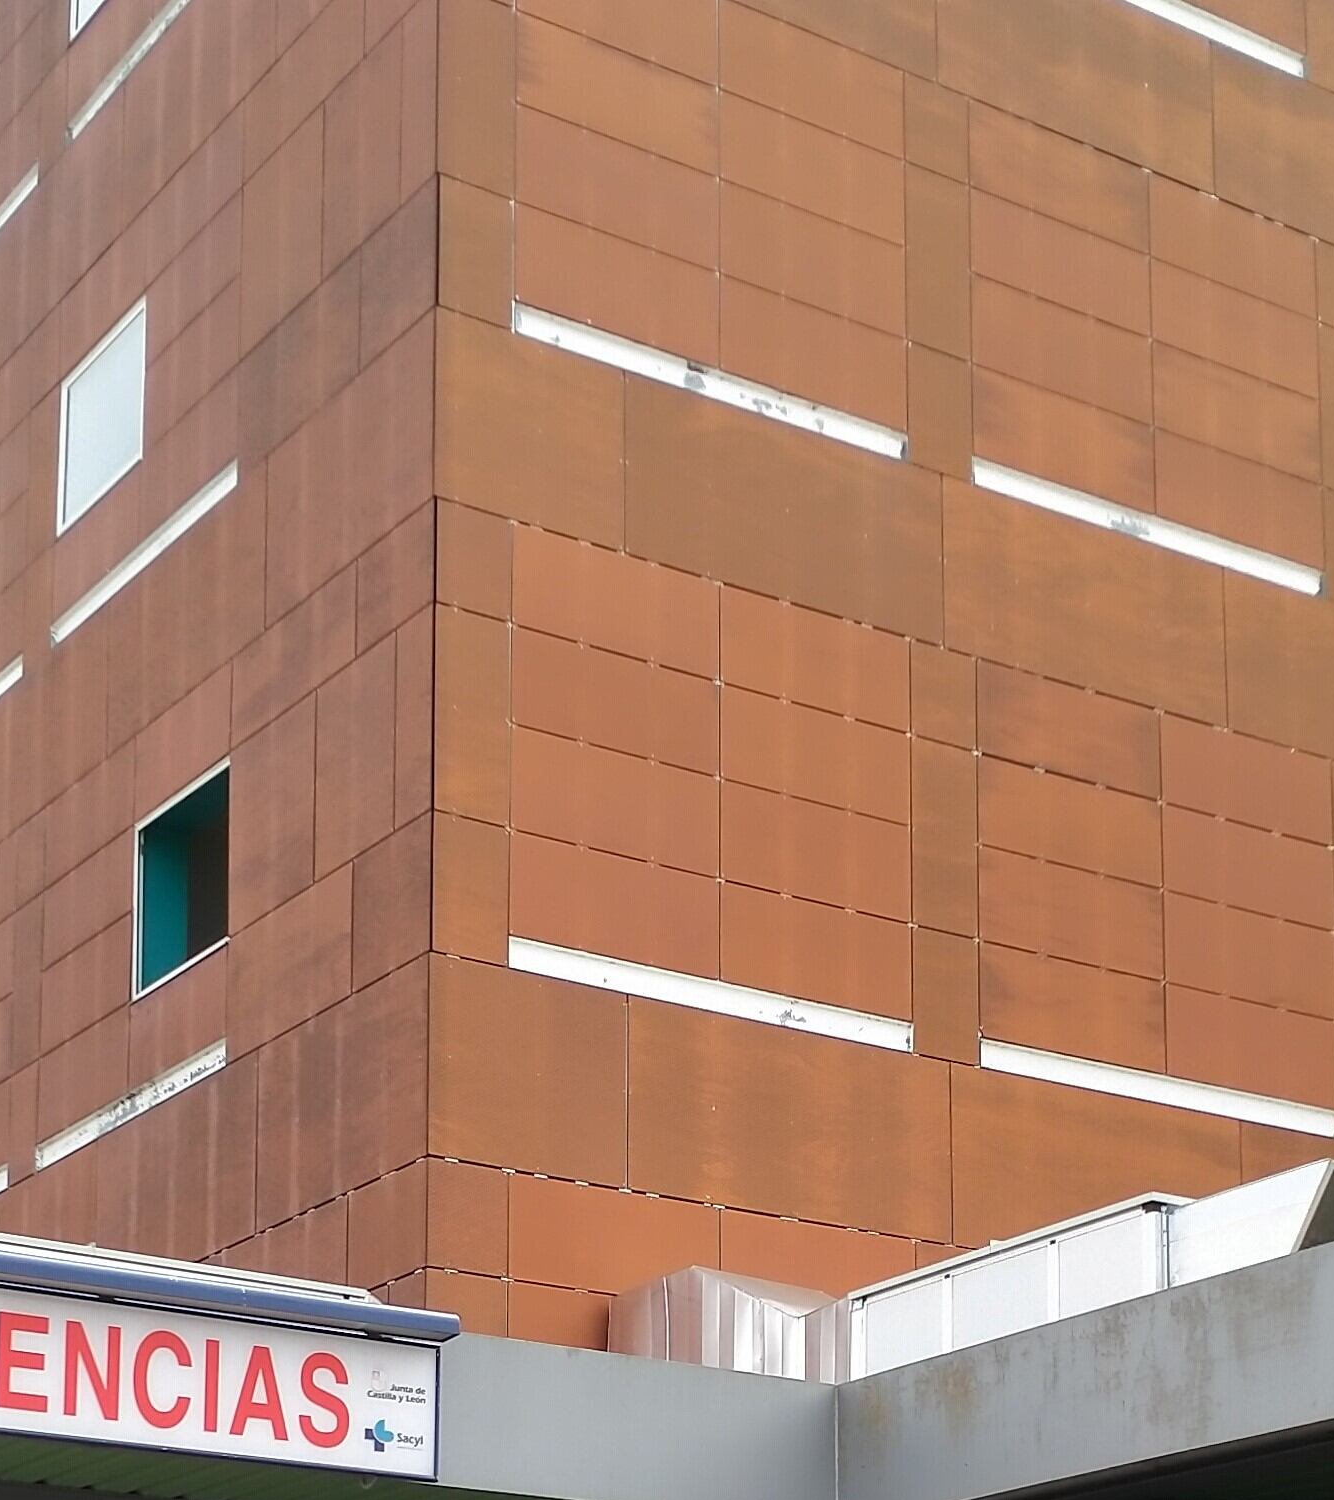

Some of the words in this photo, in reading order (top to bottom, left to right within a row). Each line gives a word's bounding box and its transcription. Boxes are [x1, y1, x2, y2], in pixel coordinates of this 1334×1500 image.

[390, 1384, 413, 1393] Junta
[415, 1386, 426, 1395] de
[367, 1390, 397, 1400] Castilla
[398, 1395, 405, 1403] y
[397, 1433, 423, 1447] Sacyl
